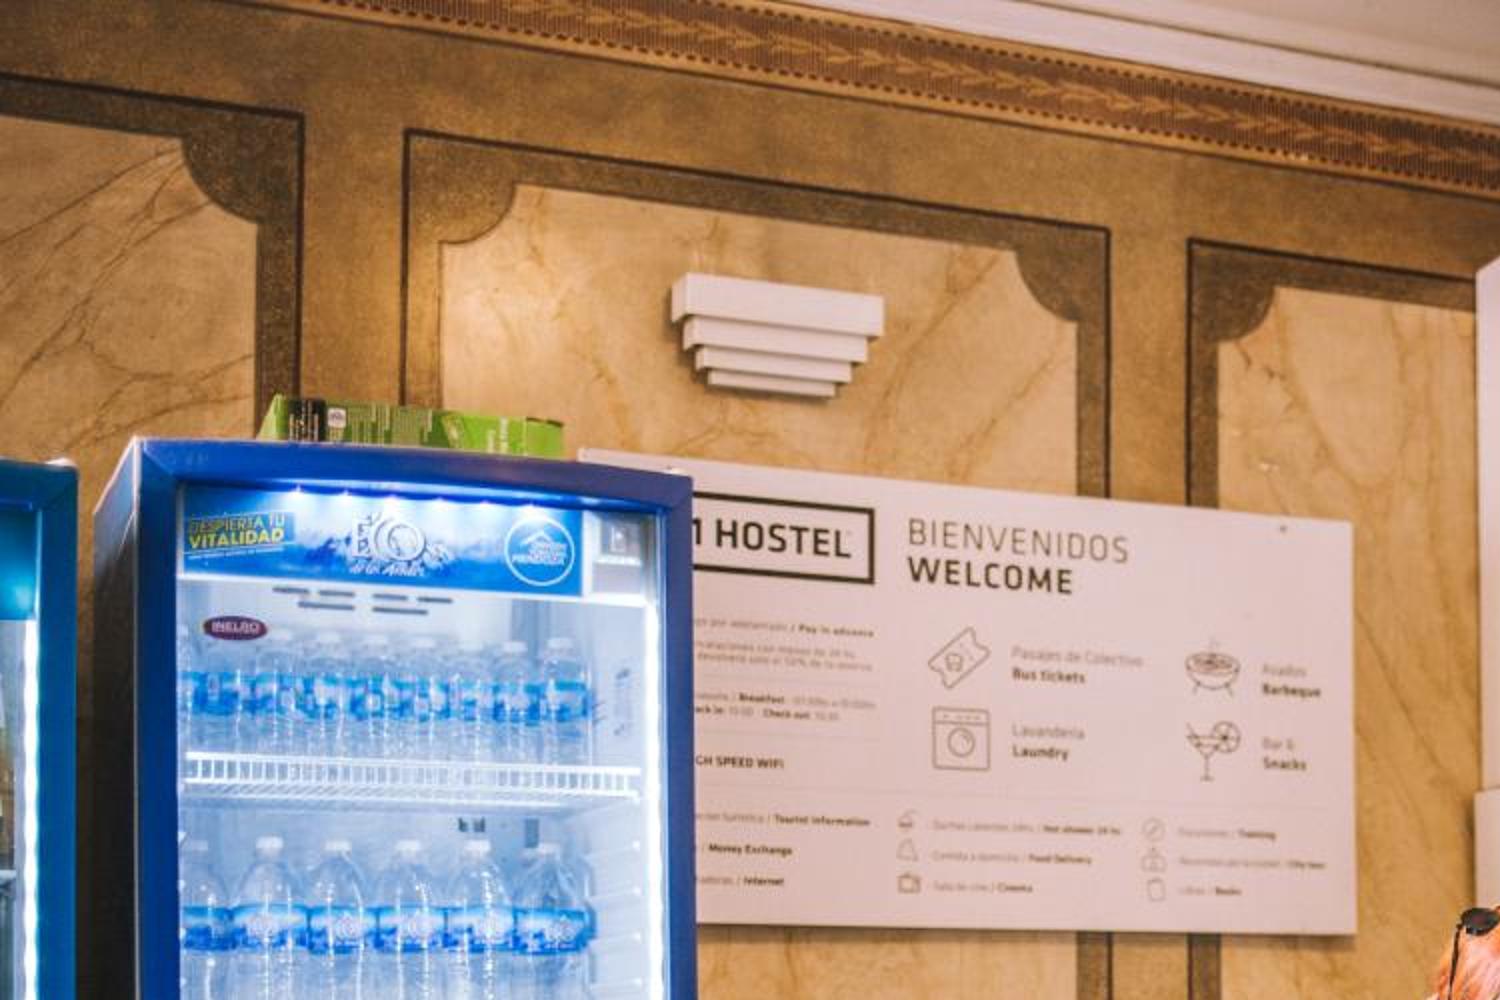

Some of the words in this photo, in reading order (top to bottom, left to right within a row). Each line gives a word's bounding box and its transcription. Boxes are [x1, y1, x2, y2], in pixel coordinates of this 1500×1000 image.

[187, 527, 286, 551] VITALIDAD
[715, 518, 853, 559] HOSTEL
[908, 517, 1130, 564] BIENVENIDOS
[907, 556, 1073, 595] WELCOME
[1011, 645, 1061, 663] Pasajes
[1063, 651, 1082, 663] de
[1012, 667, 1037, 681] Bus
[1040, 669, 1086, 684] tickets
[1262, 683, 1322, 698] Barbeque
[1011, 744, 1068, 762] Laundry
[716, 756, 753, 768] SPEED
[1262, 757, 1307, 771] Snacks
[774, 813, 809, 825] Tourist
[708, 843, 743, 856] Money
[744, 844, 793, 858] Exchange
[743, 876, 785, 886] Internet
